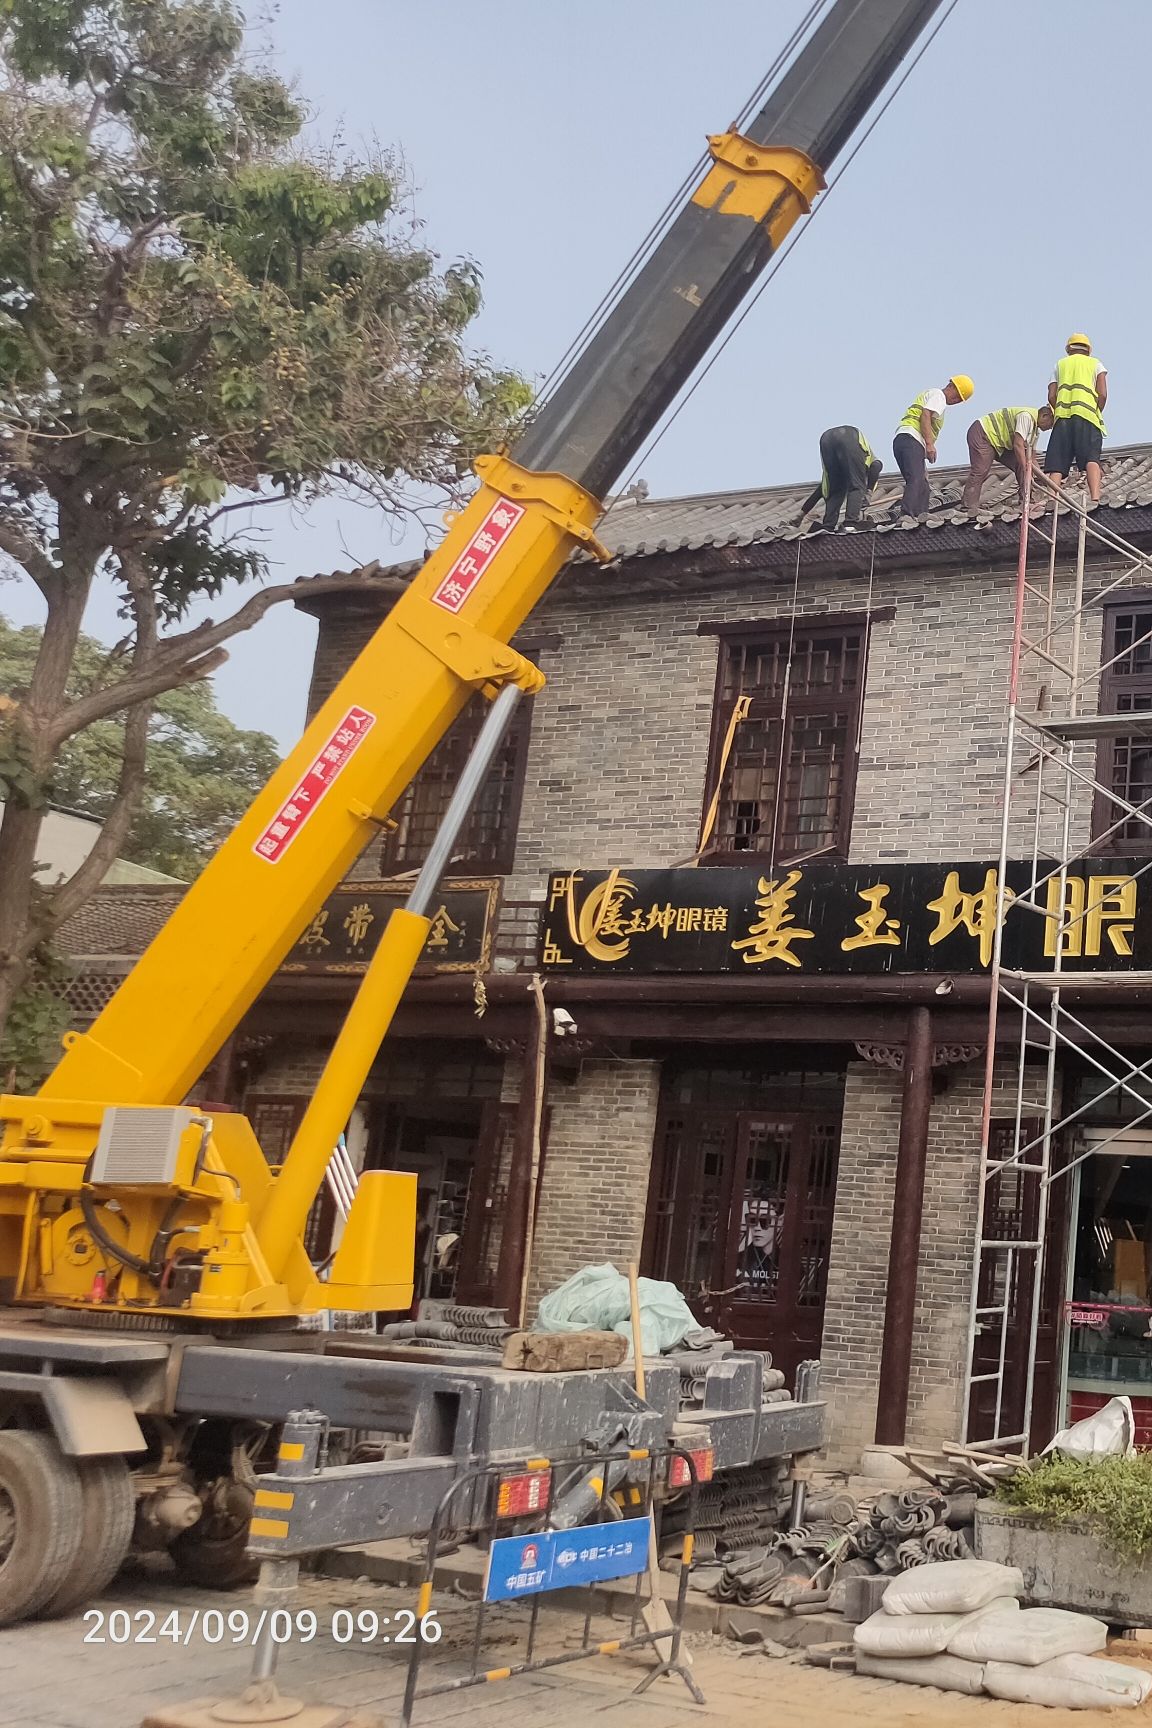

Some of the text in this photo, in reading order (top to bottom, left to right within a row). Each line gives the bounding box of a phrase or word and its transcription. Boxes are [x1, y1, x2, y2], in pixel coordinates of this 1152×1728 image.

[257, 710, 368, 857] 起重臂下 严禁站人
[600, 895, 728, 939] 姜玉坤眼镜
[506, 1569, 547, 1591] 中国五矿
